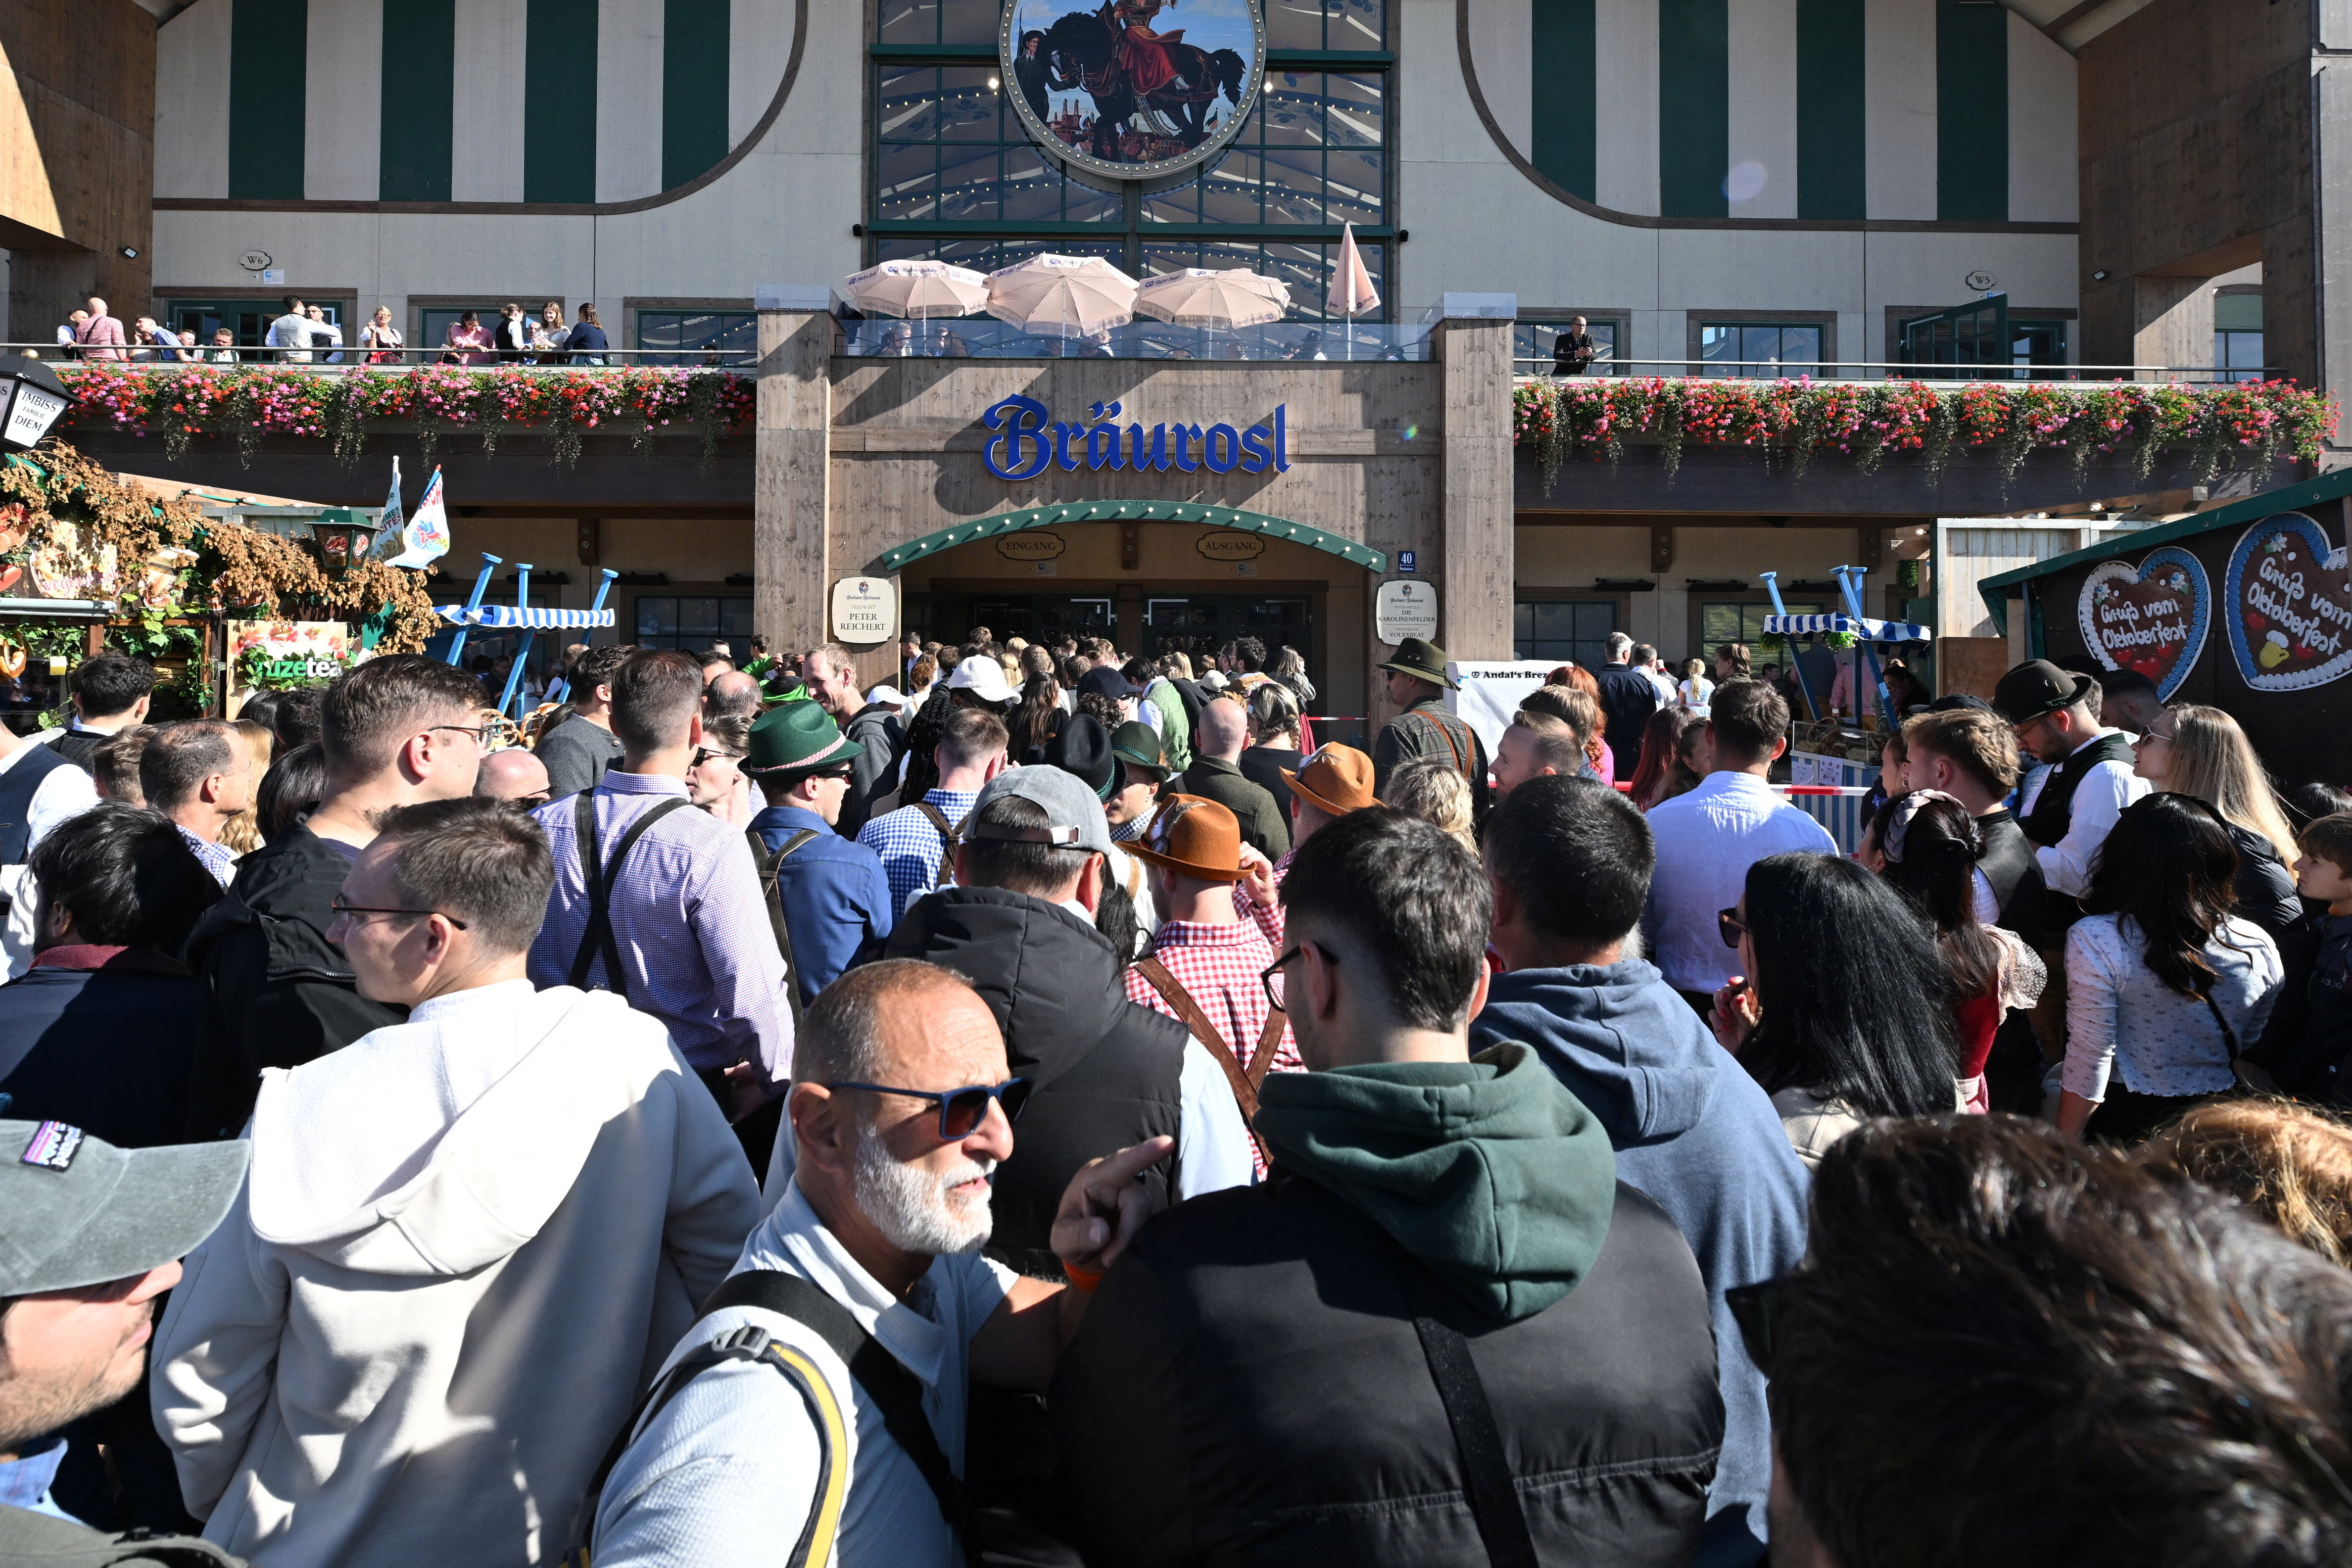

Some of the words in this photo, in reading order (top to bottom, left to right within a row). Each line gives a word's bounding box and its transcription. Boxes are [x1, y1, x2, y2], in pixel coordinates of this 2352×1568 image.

[247, 256, 263, 264] W6
[22, 391, 58, 412] IMBISS
[23, 406, 46, 419] FAMILIE
[15, 415, 43, 431] DIEM
[983, 393, 1291, 480] Bräurosl
[1006, 542, 1056, 551] EINGANG
[1204, 542, 1256, 551] AUSGANG
[1401, 553, 1412, 564] 40
[2259, 557, 2304, 601] Gruß
[2311, 593, 2352, 630] vom
[2101, 601, 2139, 626] Gruß
[2143, 598, 2180, 618] vom
[2247, 582, 2342, 655] Oktoberfest
[2103, 617, 2188, 649] Oktoberfest
